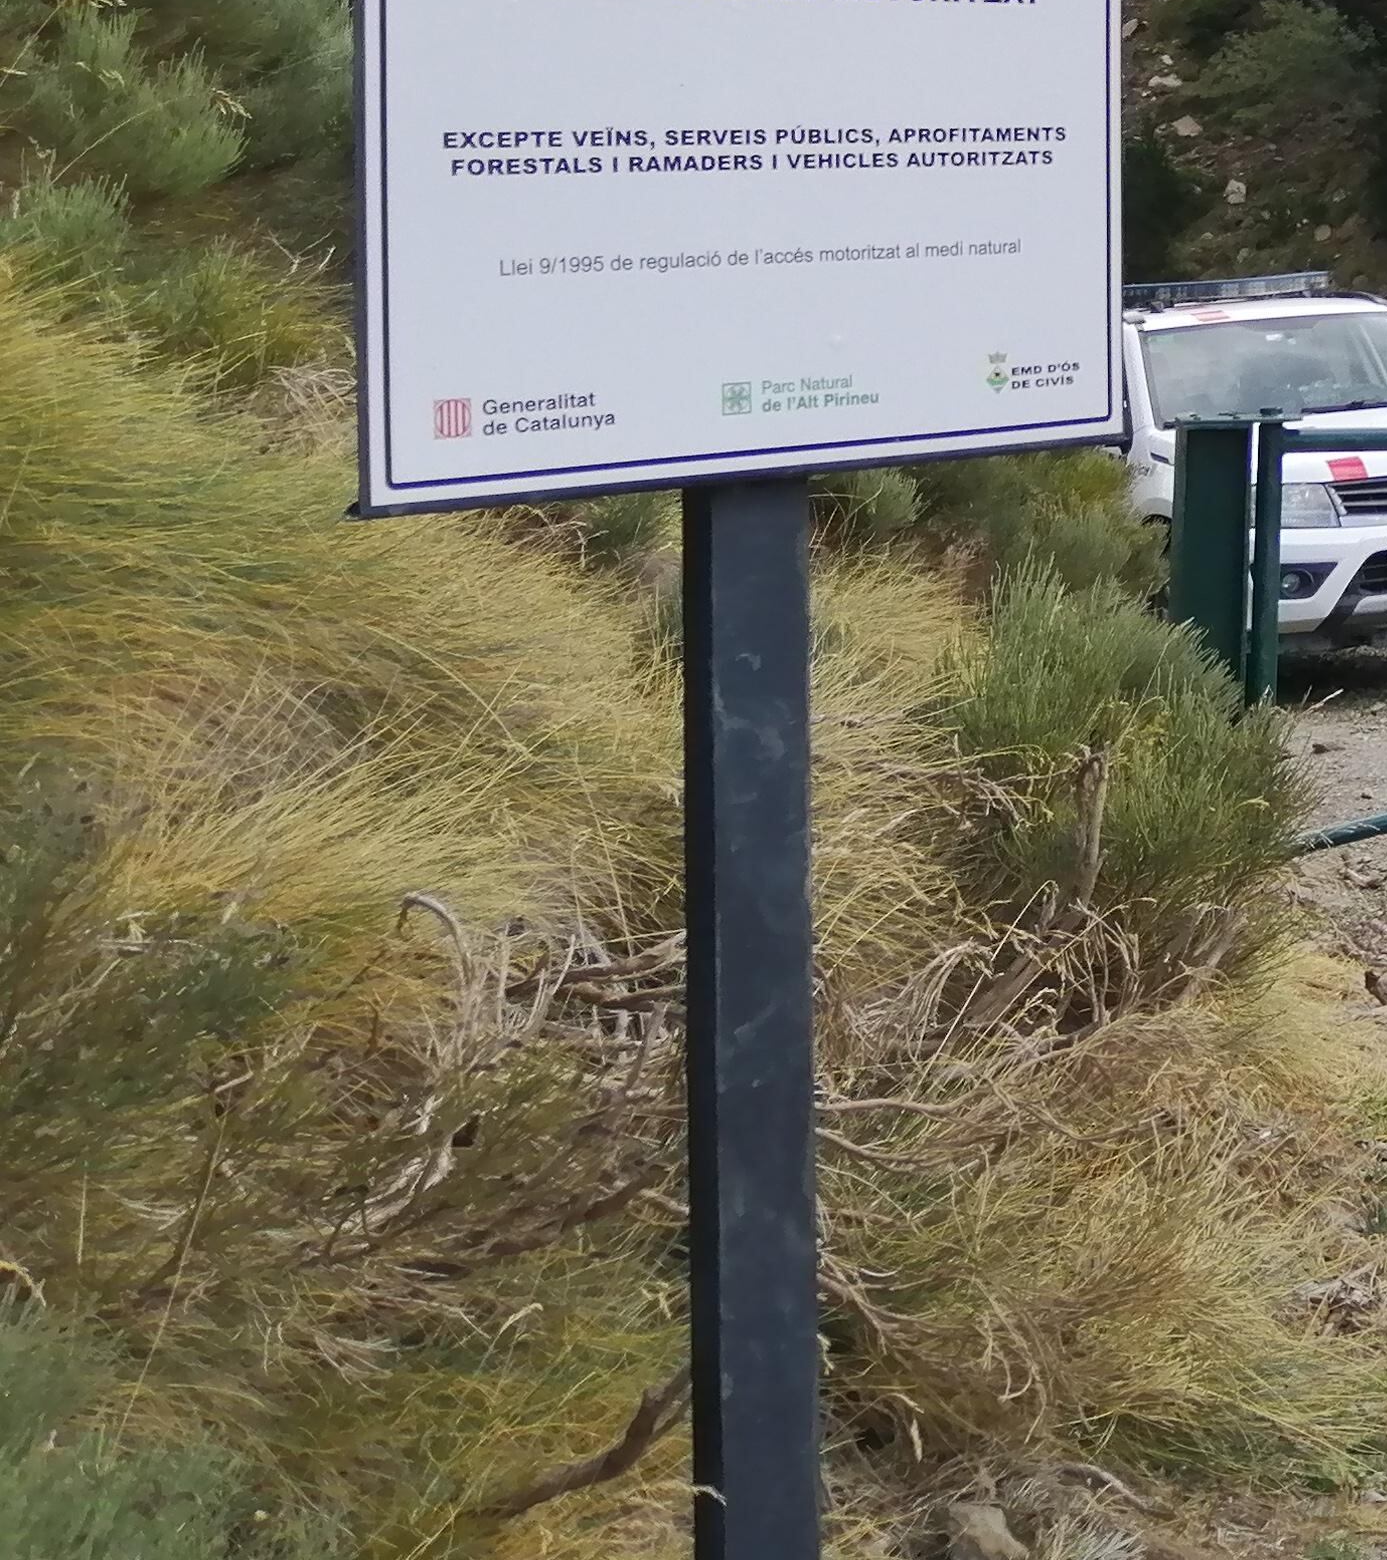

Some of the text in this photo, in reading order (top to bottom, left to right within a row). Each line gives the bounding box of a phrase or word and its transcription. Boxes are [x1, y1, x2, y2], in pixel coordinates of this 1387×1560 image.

[443, 125, 1066, 151] EXCEPTE VEÏNS, SERVEIS PÚBLICS, APROFITAMENTS
[451, 150, 1053, 177] FORESTALS I RAMADERS I VEHICLES AUTORITZATS
[499, 239, 1021, 277] Llei 9/1995 de regulació de l'accés motoritzat al medi natural
[1011, 365, 1042, 376] EMD
[761, 375, 853, 394] Parc Natural
[1011, 375, 1075, 390] DE CIVÍS
[482, 392, 596, 415] Generalitat
[762, 392, 879, 412] de l'Alt Pirineu
[482, 413, 616, 436] de Catalunya
